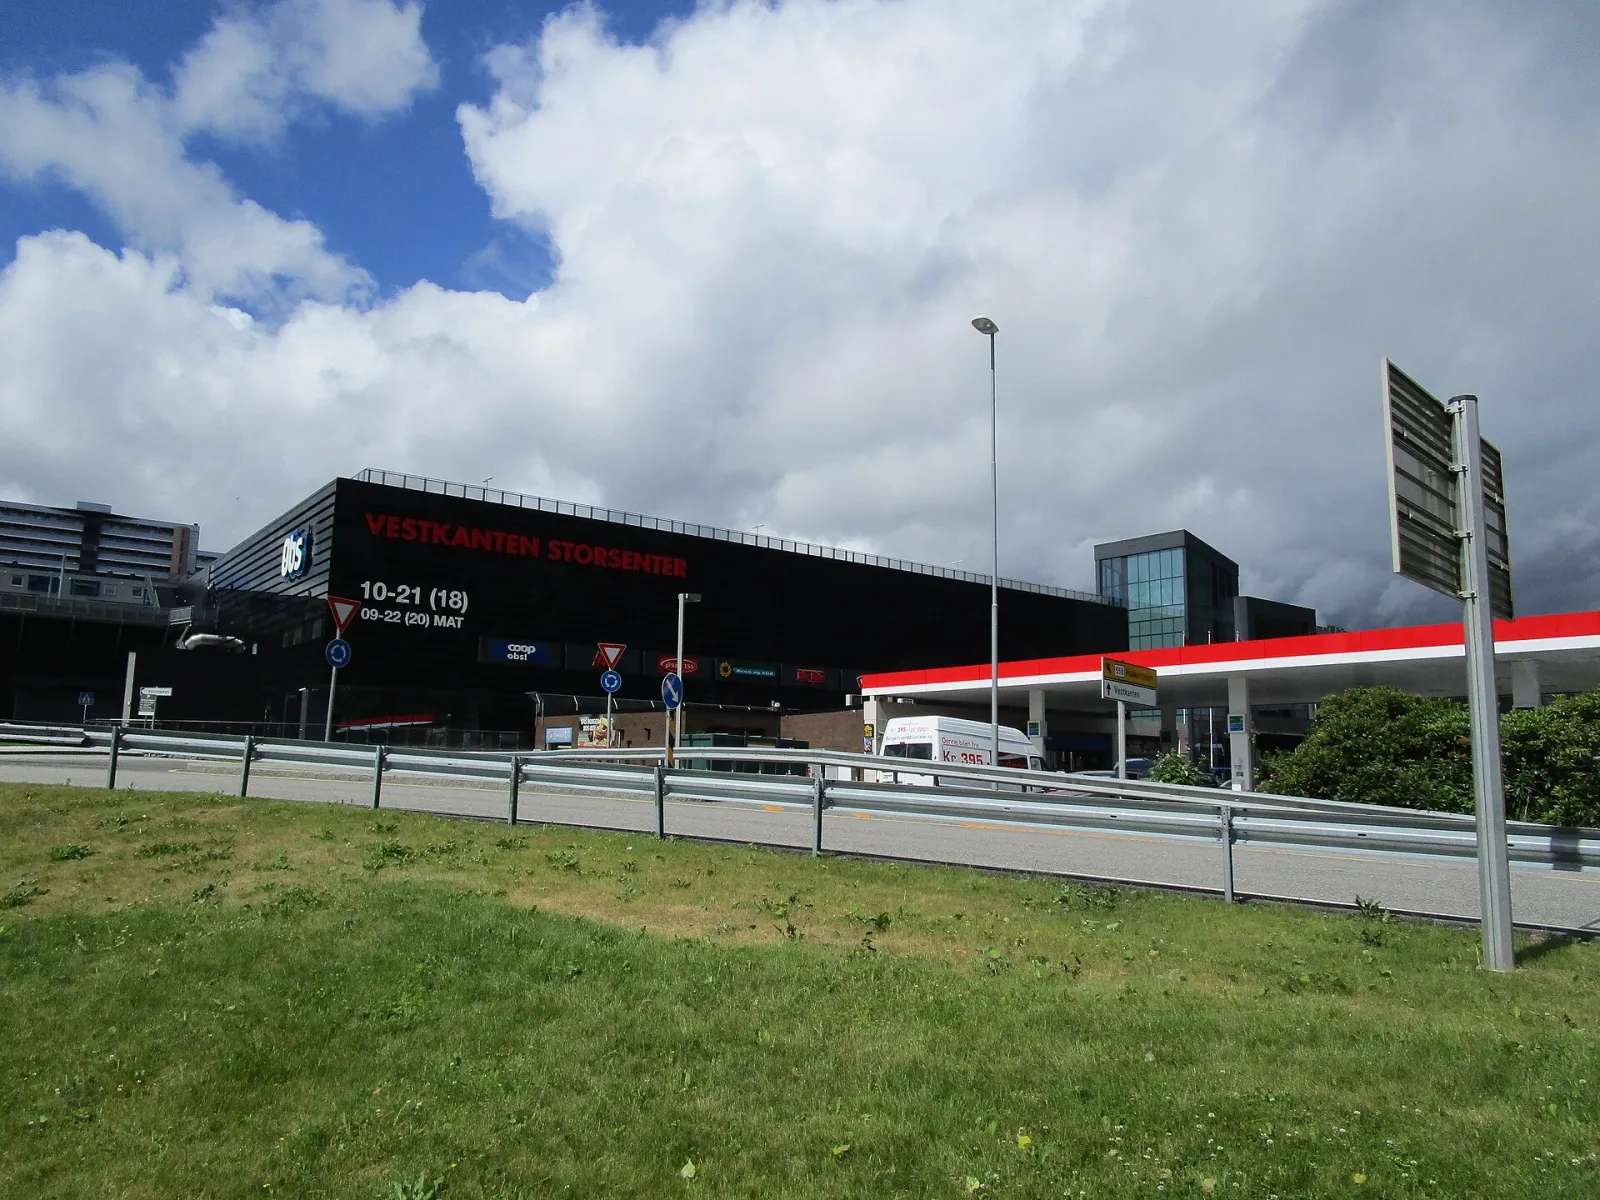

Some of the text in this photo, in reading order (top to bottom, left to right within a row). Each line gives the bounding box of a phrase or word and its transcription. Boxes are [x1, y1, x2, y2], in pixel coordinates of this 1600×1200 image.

[365, 512, 687, 578] VESTKANTEN STORSENTER
[360, 581, 468, 614] 10-21 (18)
[360, 607, 465, 629] 09-22 (20) MAT
[507, 643, 536, 655] coop
[507, 652, 528, 661] obs!
[1114, 685, 1140, 699] Vestkanten
[941, 736, 959, 746] Denne
[943, 750, 957, 763] Kr
